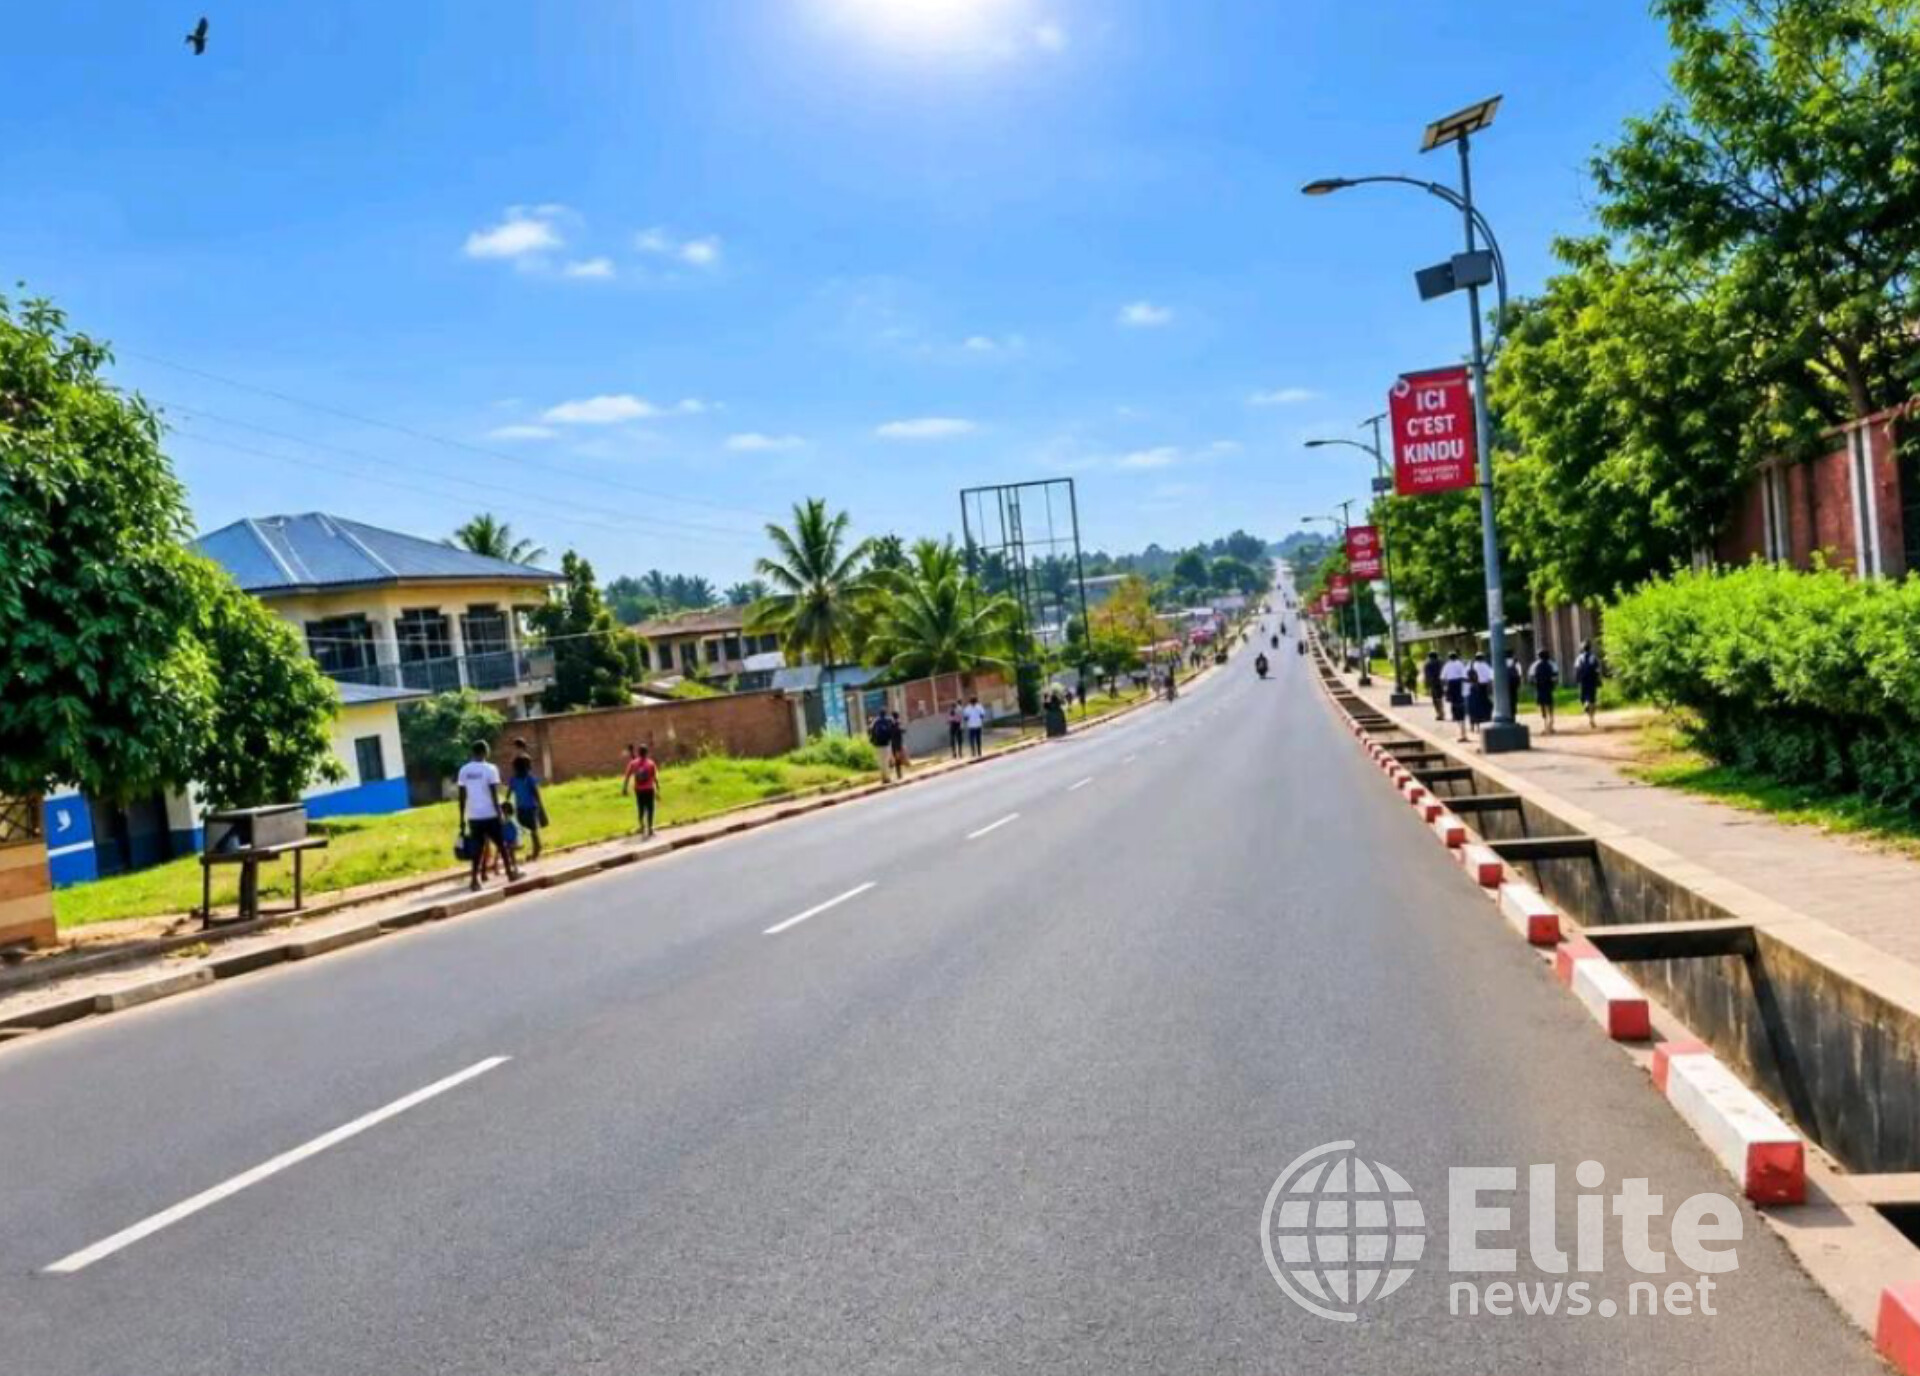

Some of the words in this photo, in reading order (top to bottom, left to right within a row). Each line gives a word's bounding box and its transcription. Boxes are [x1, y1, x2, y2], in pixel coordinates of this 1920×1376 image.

[1416, 389, 1446, 412] ICI
[1407, 414, 1456, 437] C'EST
[1403, 438, 1465, 464] KINDU
